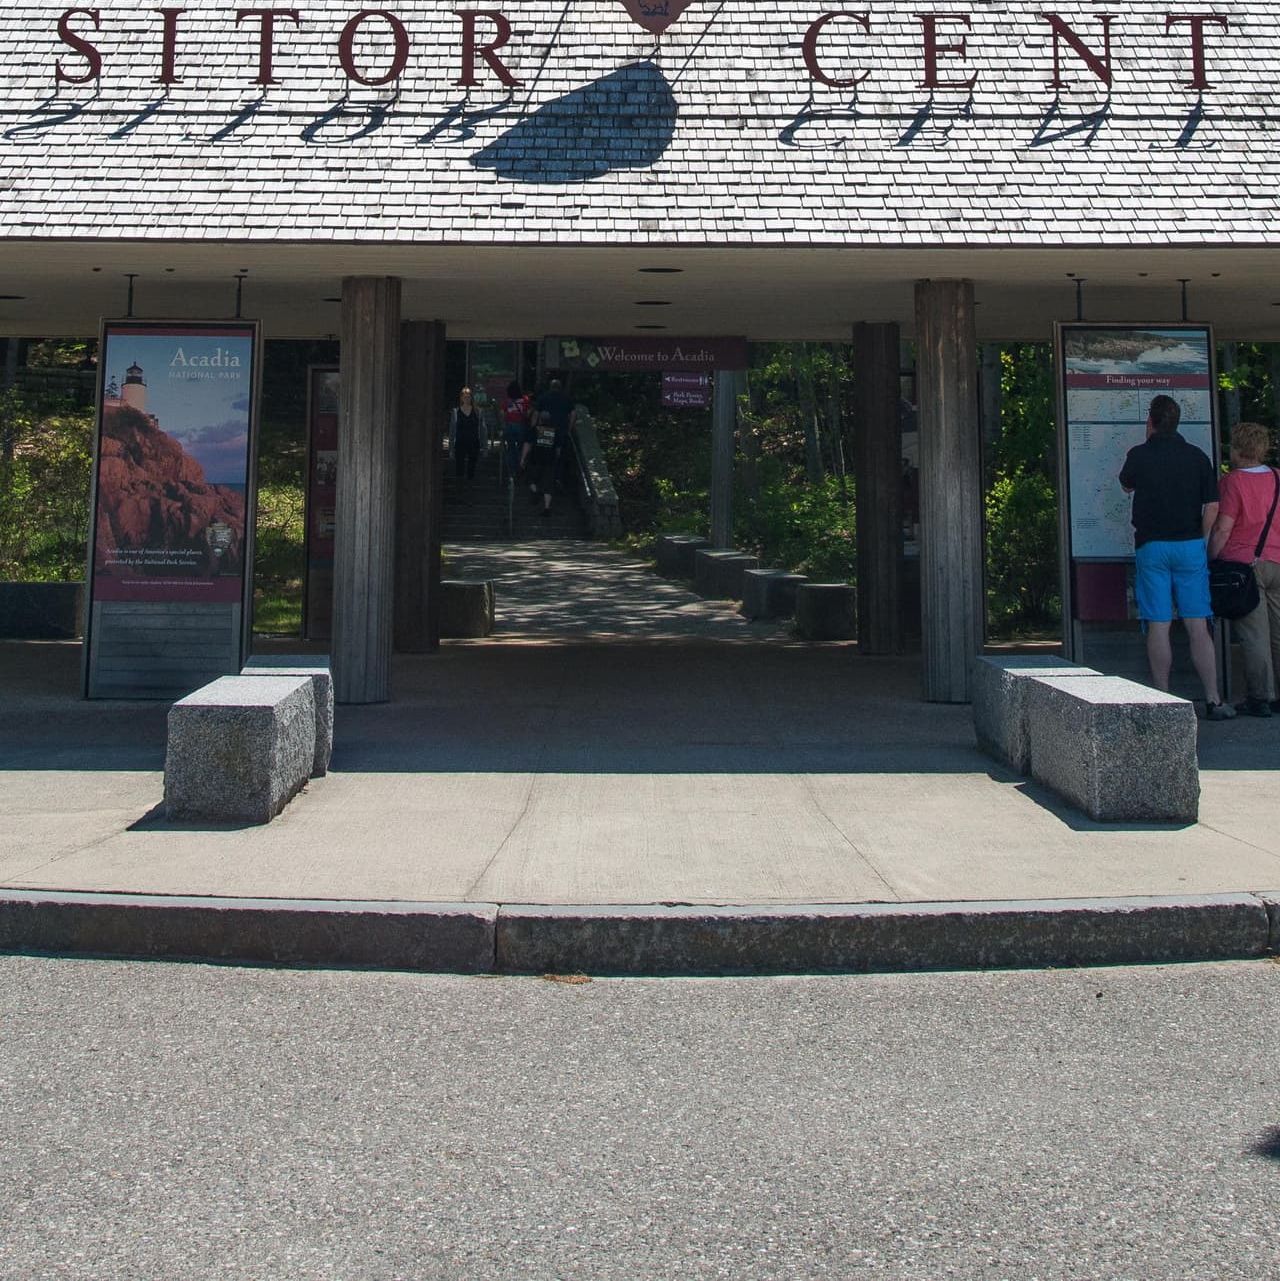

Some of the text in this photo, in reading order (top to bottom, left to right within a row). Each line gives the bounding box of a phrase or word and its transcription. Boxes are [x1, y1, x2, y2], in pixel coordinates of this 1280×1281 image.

[169, 347, 241, 367] Acadia
[597, 346, 714, 361] Welcome to Acadia
[169, 371, 241, 380] NATIONAL PARK
[1106, 375, 1170, 387] Finding your way
